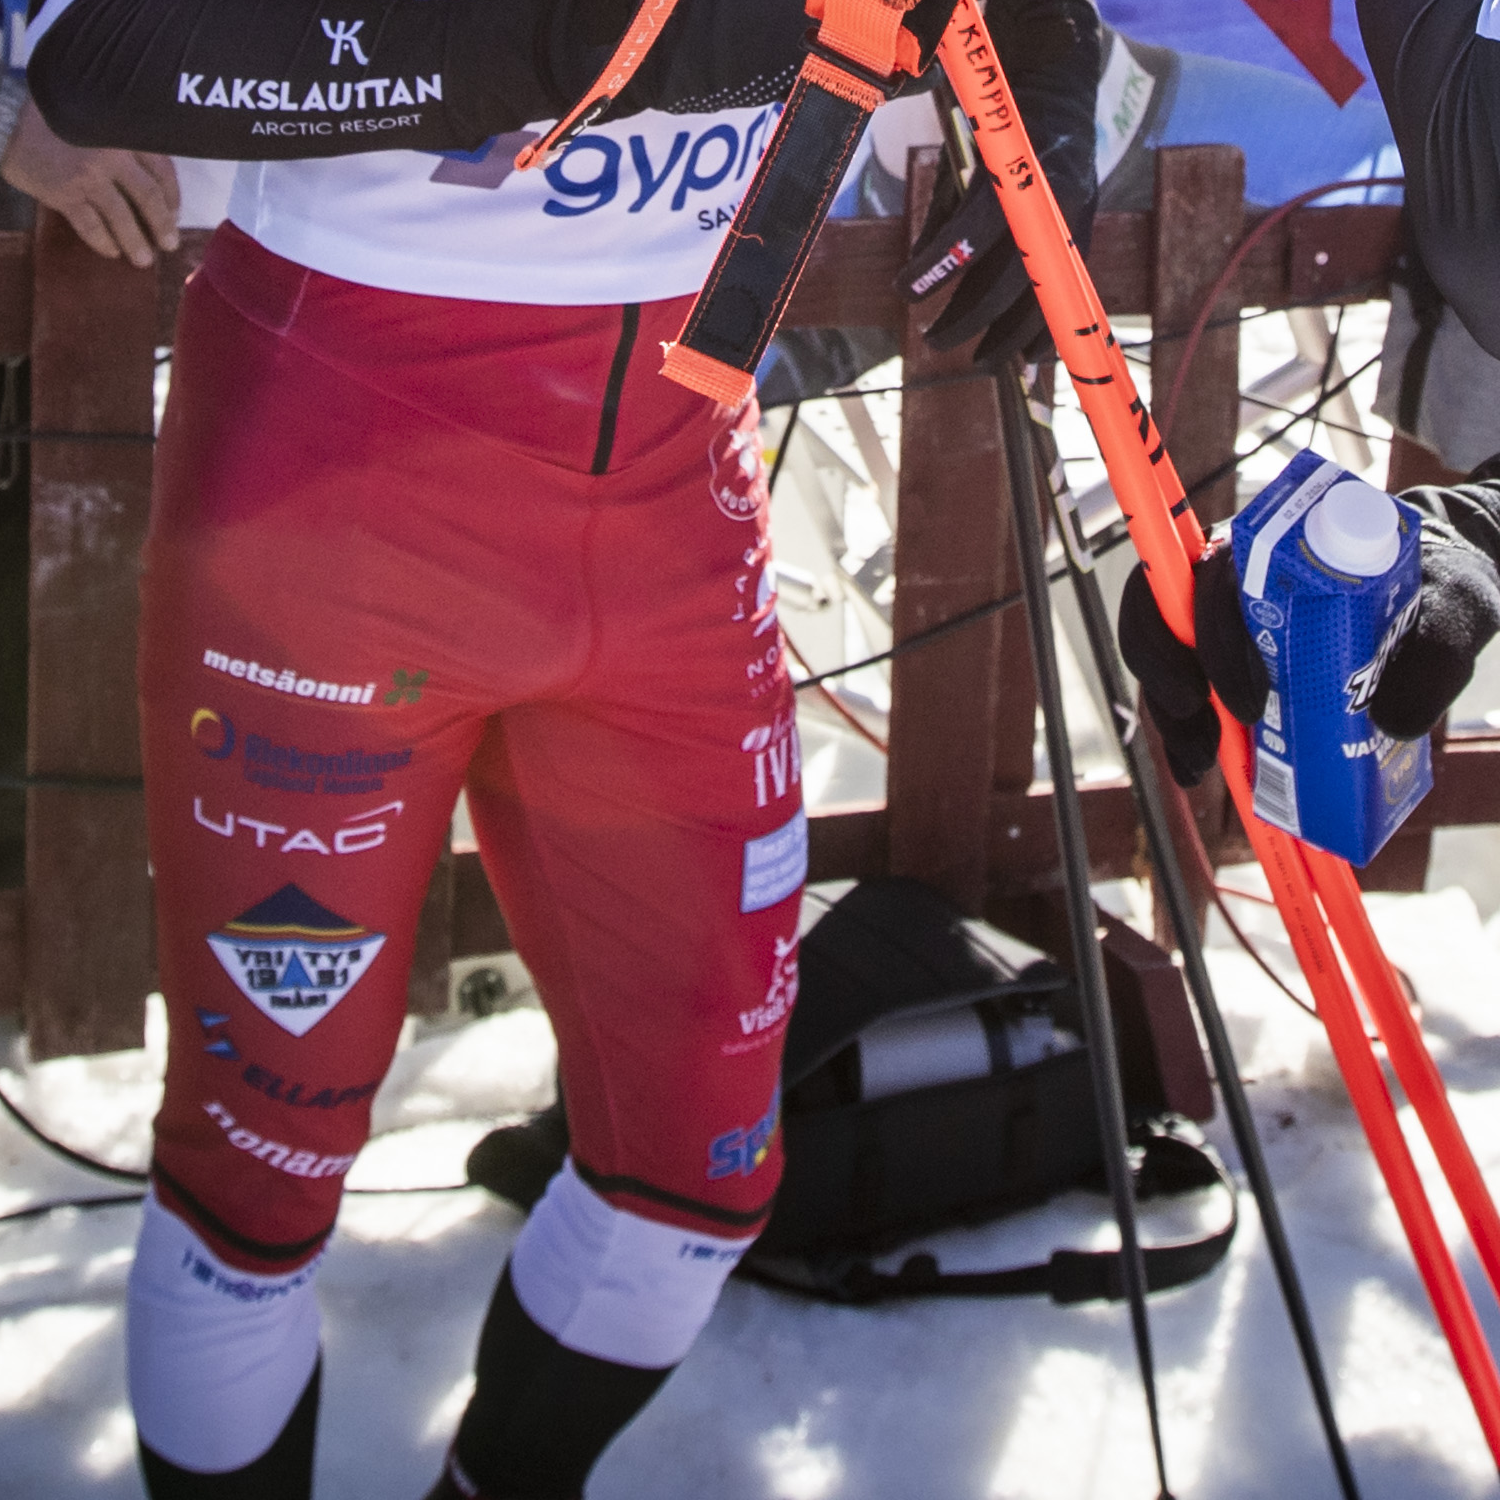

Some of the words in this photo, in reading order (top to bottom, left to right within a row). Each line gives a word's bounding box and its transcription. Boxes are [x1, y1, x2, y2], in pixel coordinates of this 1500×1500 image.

[177, 72, 443, 112] KAKSLAUTTAN
[957, 23, 1014, 134] KEMPPI
[251, 120, 333, 136] ARCTIC
[339, 112, 423, 135] RESORT
[203, 649, 376, 705] metsäonni
[193, 797, 392, 855] UTAC
